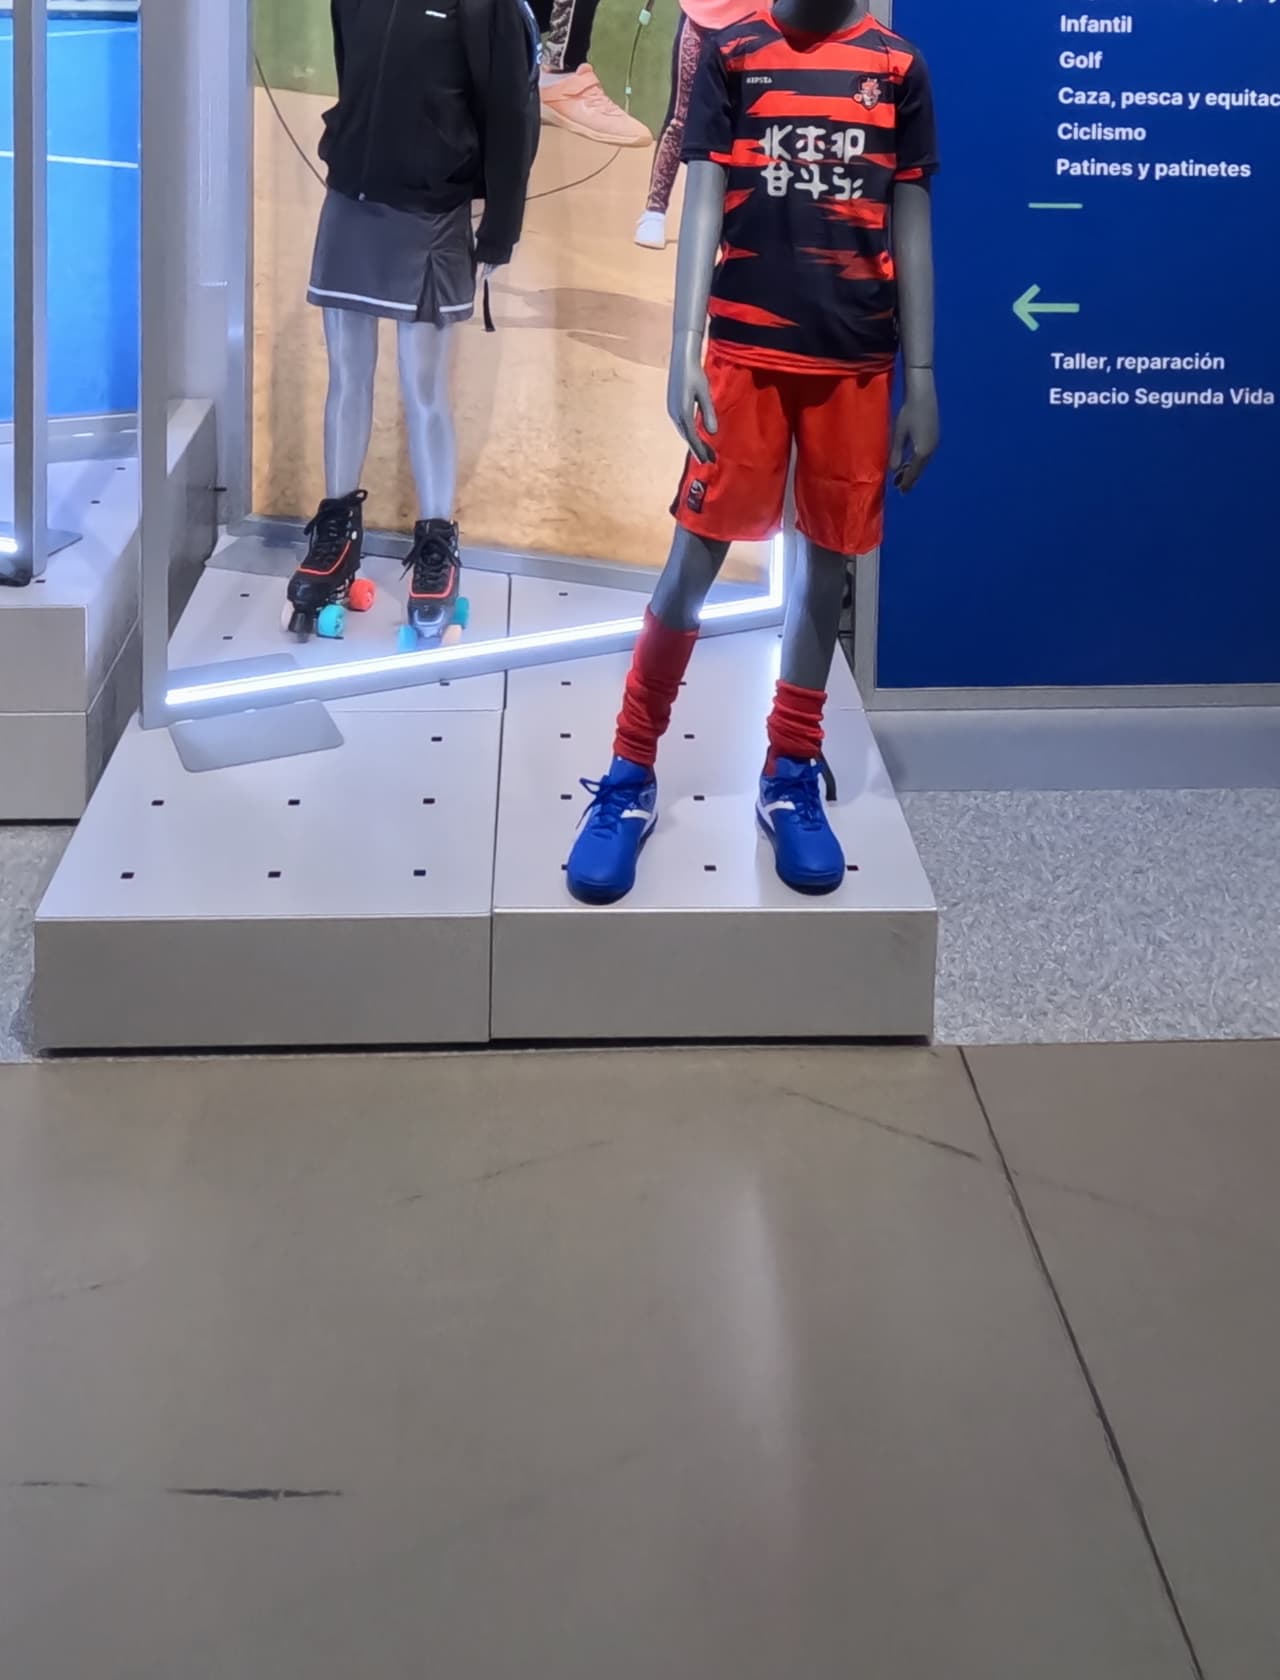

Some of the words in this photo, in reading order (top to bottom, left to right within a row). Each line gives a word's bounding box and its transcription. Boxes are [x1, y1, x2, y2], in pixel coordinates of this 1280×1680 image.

[1061, 15, 1132, 33] Infantil
[1060, 51, 1102, 68] Golf
[1058, 87, 1115, 108] Caza,
[1121, 92, 1183, 109] pesca
[1188, 93, 1200, 109] y
[1058, 123, 1146, 140] Ciclismo
[1057, 158, 1133, 176] Patines
[1138, 163, 1150, 180] y
[1155, 160, 1251, 180] patinetes
[1051, 353, 1110, 372] Taller,
[1117, 353, 1224, 373] reparación
[1050, 388, 1129, 408] Espacio
[1135, 388, 1223, 408] Segunda
[1230, 388, 1274, 404] Vida
